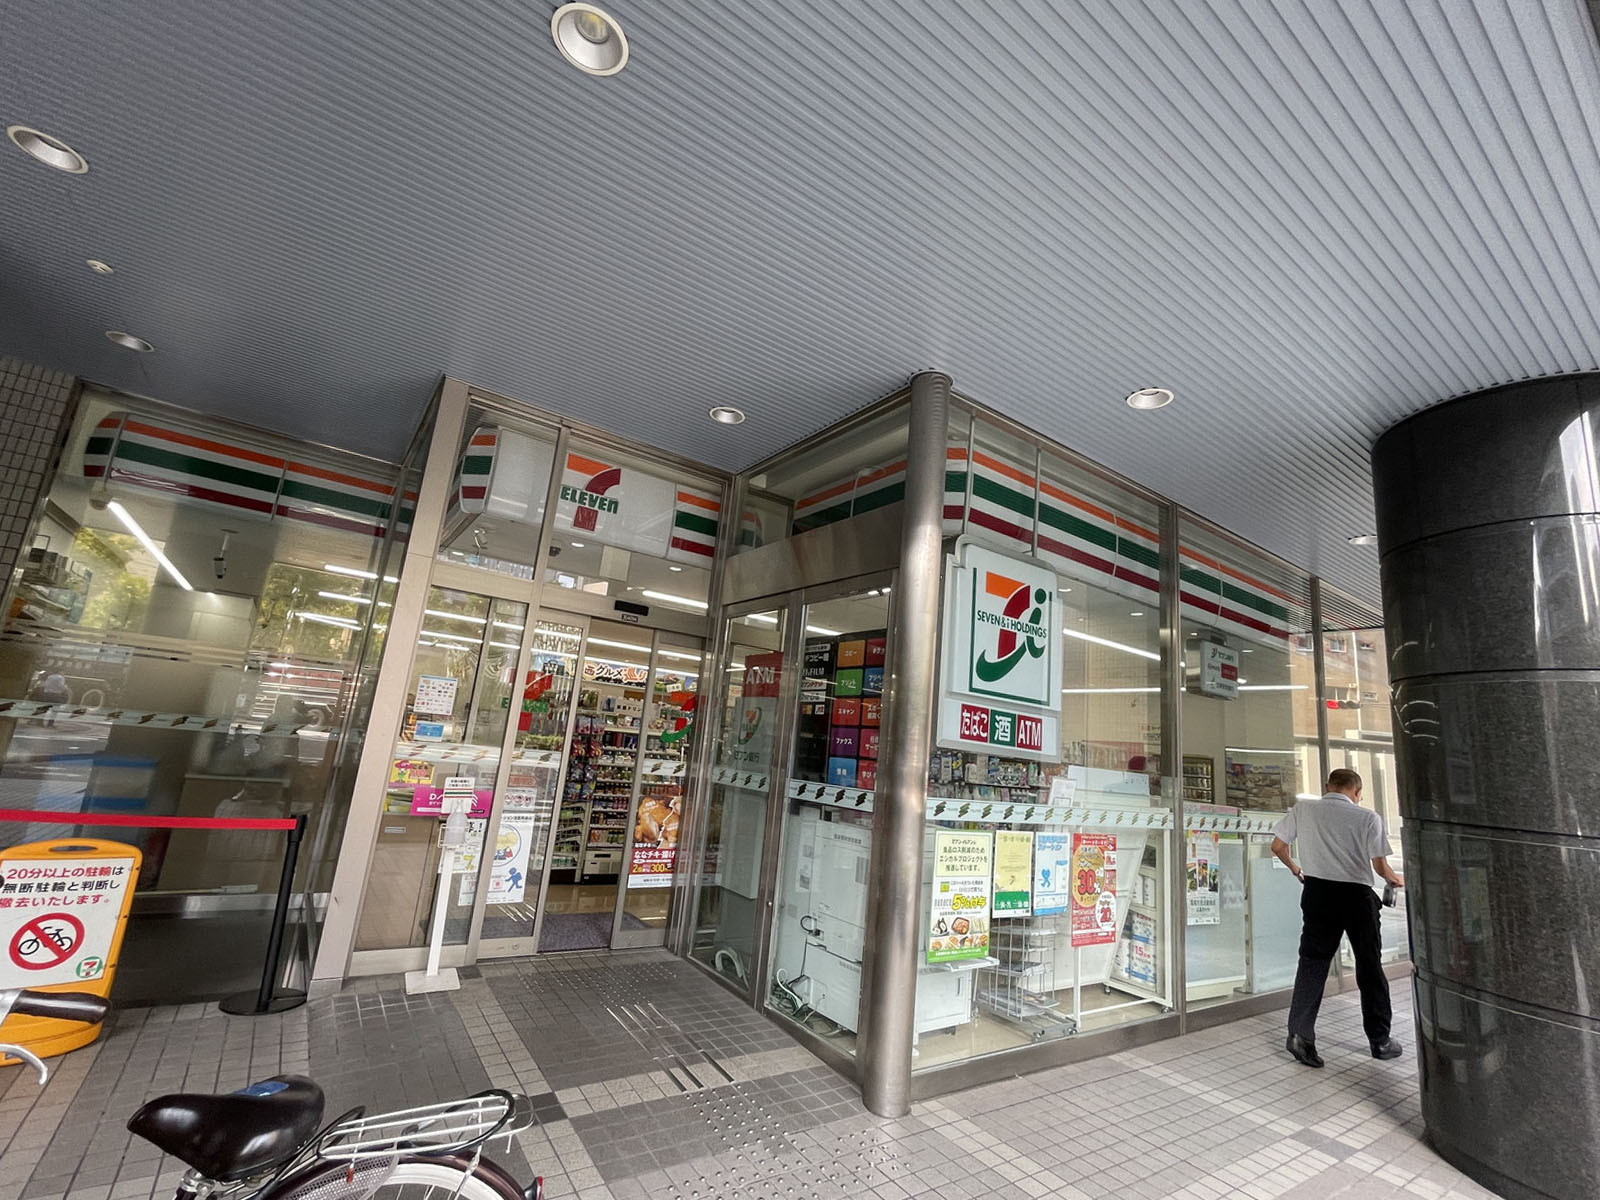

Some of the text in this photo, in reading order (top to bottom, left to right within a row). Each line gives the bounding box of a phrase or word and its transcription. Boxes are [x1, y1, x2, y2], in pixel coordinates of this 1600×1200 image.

[1010, 621, 1047, 638] HOLDINGS
[746, 667, 775, 684] ATM
[961, 709, 1041, 746] たばこ 酒 ATM
[7, 866, 124, 879] 20分以上の駐輪は
[2, 880, 120, 894] 無断駐輪と判断し
